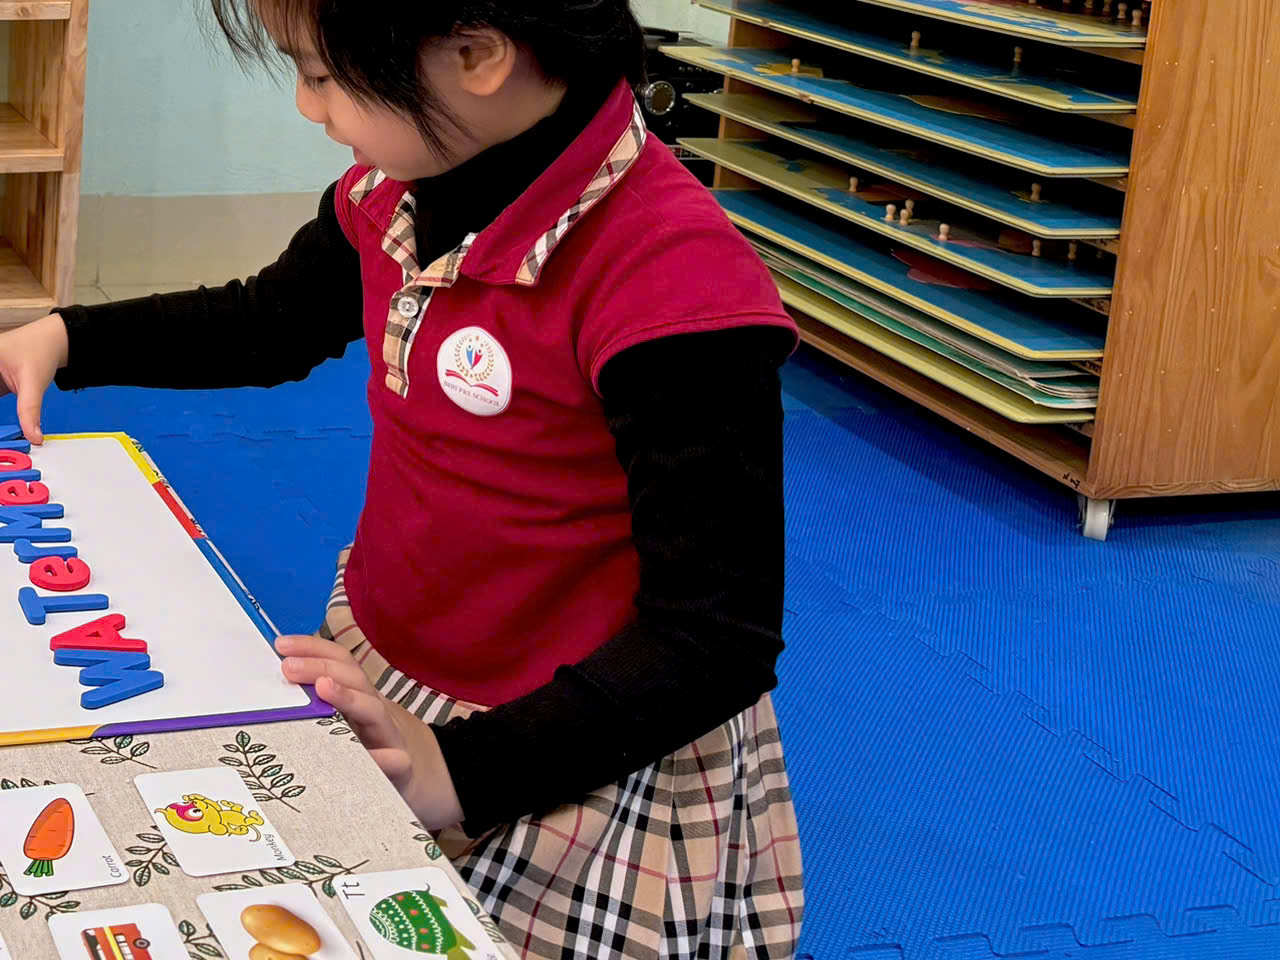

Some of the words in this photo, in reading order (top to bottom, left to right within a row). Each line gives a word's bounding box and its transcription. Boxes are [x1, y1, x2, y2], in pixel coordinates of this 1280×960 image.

[263, 833, 287, 861] Monkey
[101, 854, 122, 878] Carrot
[342, 880, 366, 900] Tt
